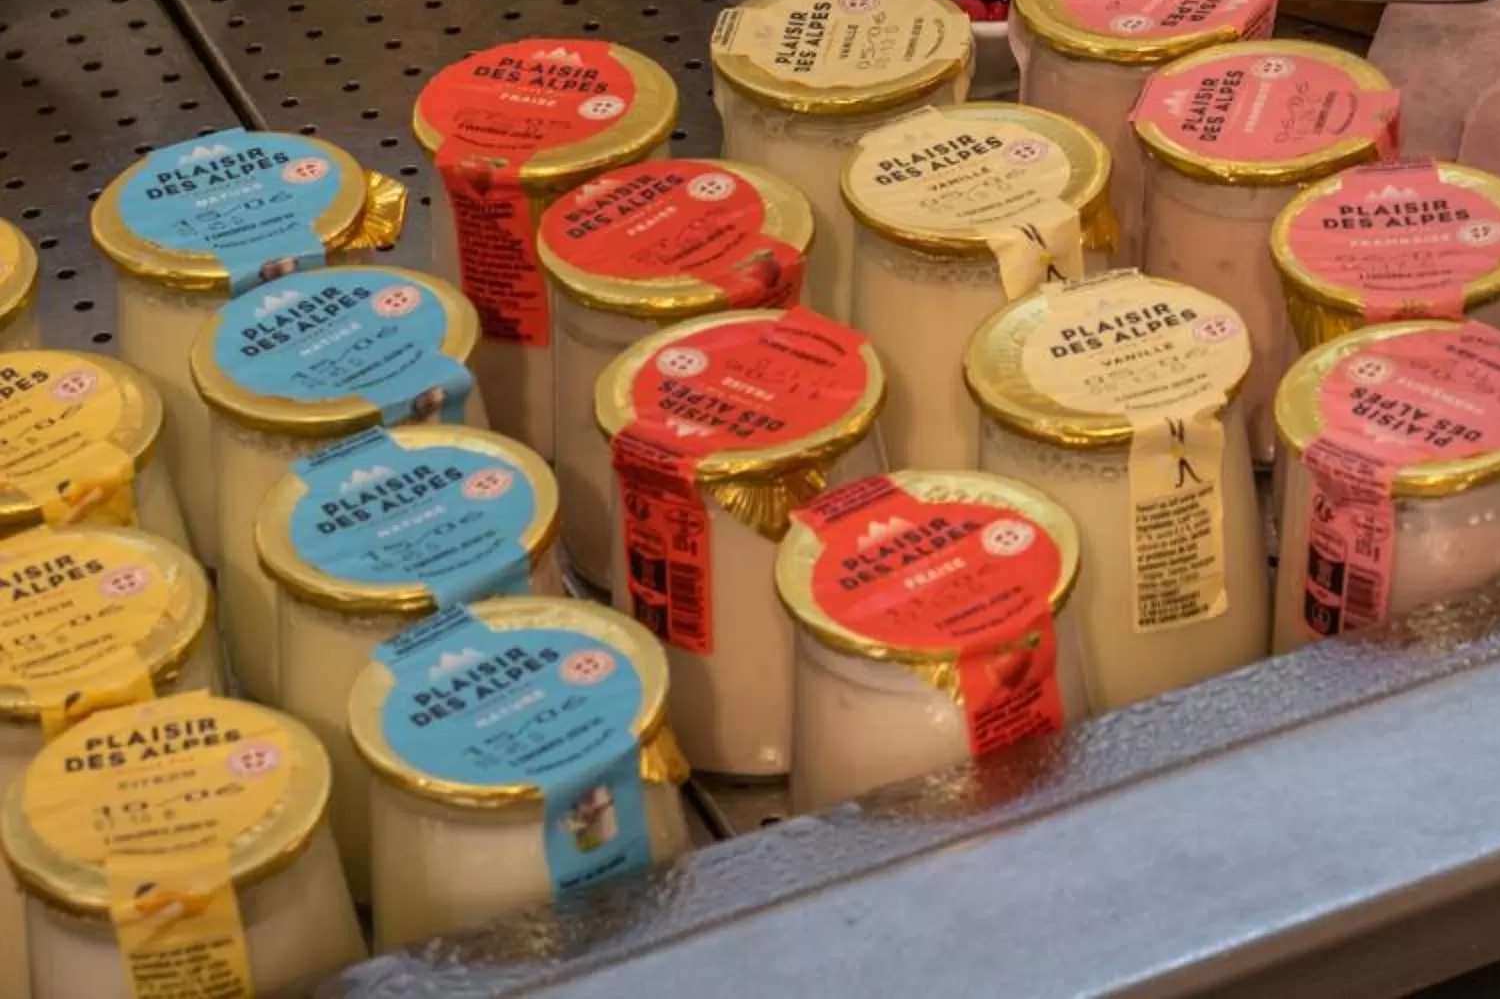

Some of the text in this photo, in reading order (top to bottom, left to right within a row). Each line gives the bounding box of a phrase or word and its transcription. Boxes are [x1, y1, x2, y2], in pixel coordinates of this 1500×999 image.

[775, 11, 809, 66] PLAISIR
[810, 0, 833, 46] ALPES
[474, 65, 609, 94] DES ALPES
[499, 57, 600, 79] PLAISIR
[1181, 77, 1220, 132] PLAISIR
[1200, 69, 1245, 142] DES ALPES
[145, 152, 291, 200] DES ALPES
[155, 147, 265, 184] PLAISIR
[874, 135, 1004, 186] DES ALPES
[878, 133, 976, 173] PLAISIR
[564, 174, 657, 222] PLAISIR
[566, 174, 685, 240] DES ALPES
[1322, 209, 1471, 230] DES ALPES
[1338, 199, 1450, 217] PLAISIR
[240, 286, 373, 358] DES ALPES
[241, 285, 345, 342] PLAISIR
[1050, 308, 1199, 359] DES ALPES
[1061, 302, 1173, 342] PLAISIR
[658, 379, 785, 433] DES ALPES
[658, 397, 755, 437] PLAISIR
[1349, 387, 1483, 443] DES ALPES
[1351, 402, 1454, 448] PLAISIR
[315, 466, 465, 536] DES ALPES
[320, 464, 434, 518] PLAISIR
[838, 520, 983, 591] DES ALPES
[841, 517, 950, 572] PLAISIR
[0, 554, 74, 589] AISIR
[13, 559, 105, 602] ALPES
[409, 648, 562, 729] DES ALPES
[411, 645, 529, 707] PLAISIR
[64, 729, 243, 774] DES ALPES
[84, 716, 219, 752] PLAISIR
